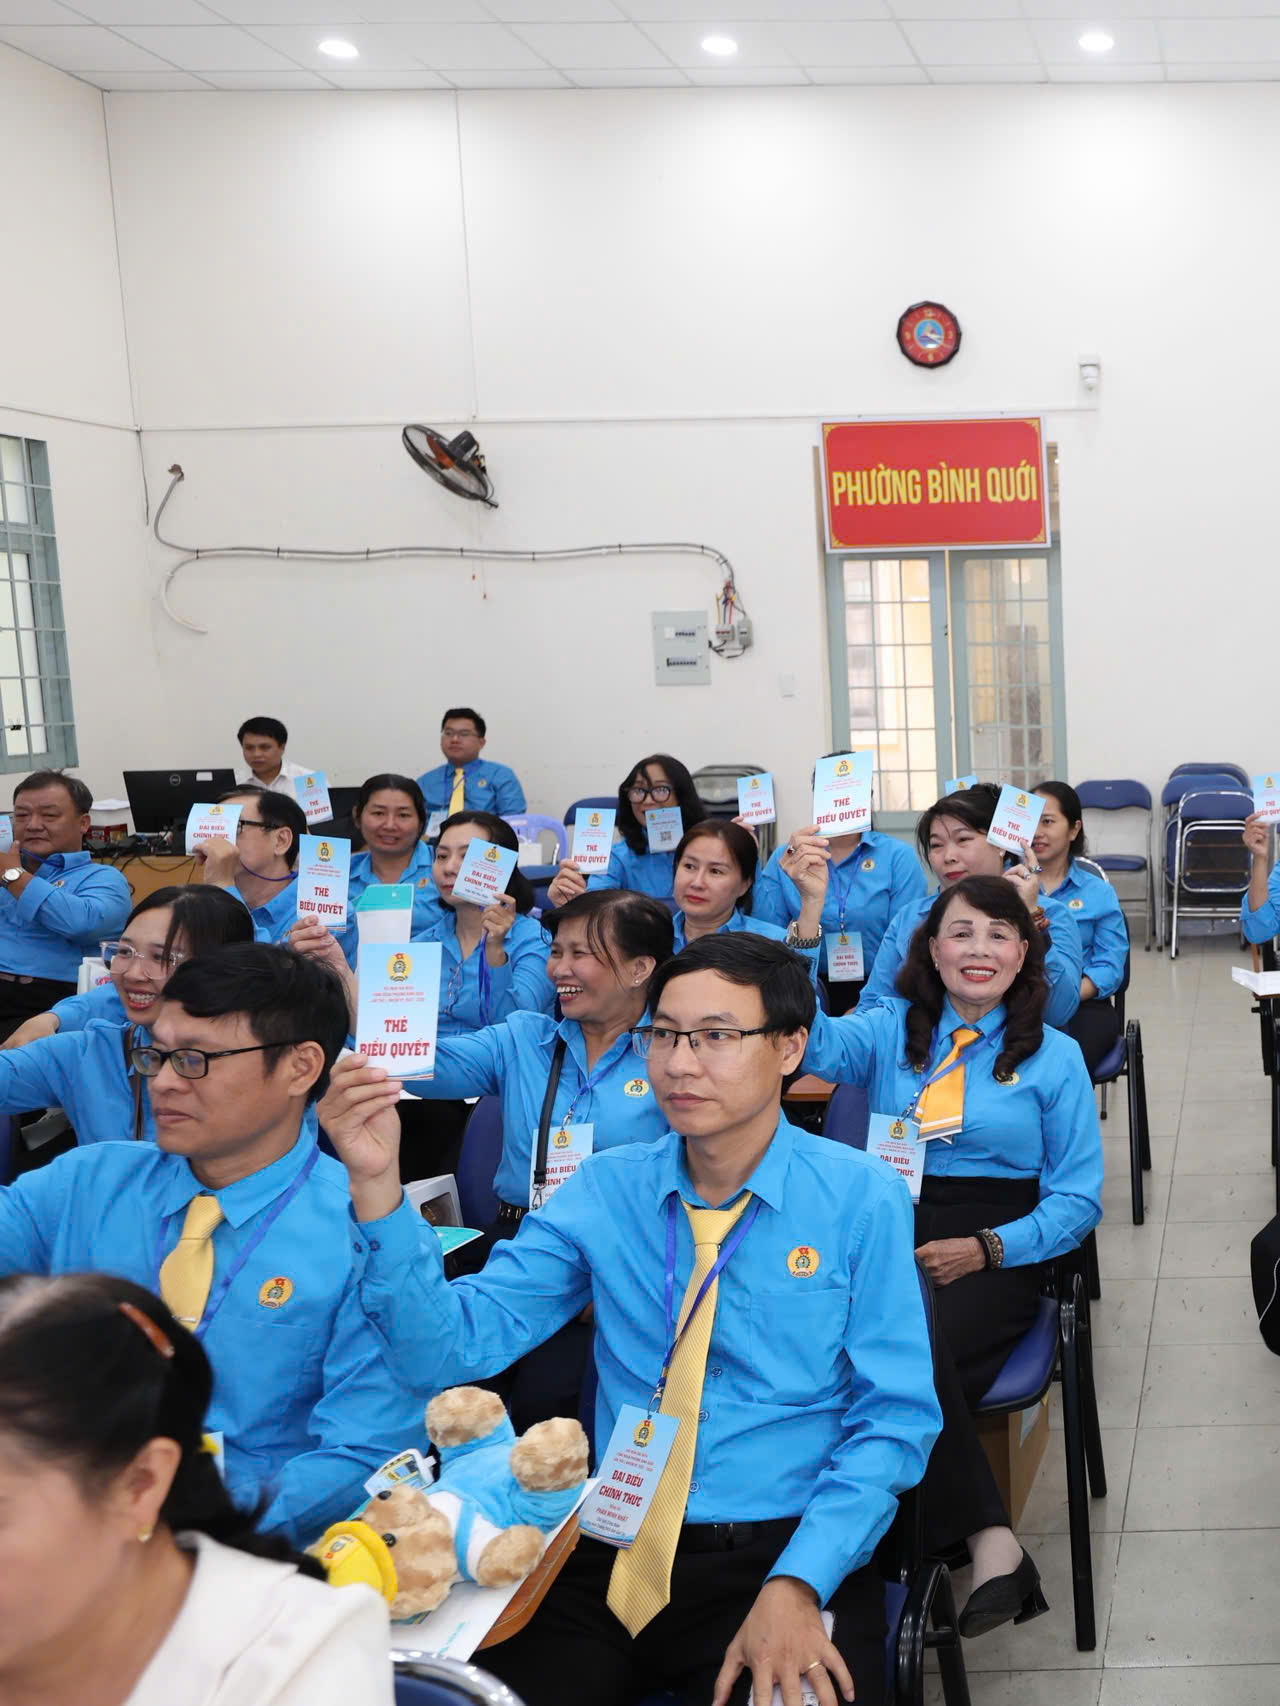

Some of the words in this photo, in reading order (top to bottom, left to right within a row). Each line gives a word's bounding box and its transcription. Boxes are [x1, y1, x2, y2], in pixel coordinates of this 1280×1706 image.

[832, 462, 922, 506] PHƯỜNG
[927, 461, 981, 504] BÌNH
[986, 459, 1038, 504] QUỚI
[384, 1016, 408, 1032] THẺ
[360, 1037, 387, 1056] BIỂU
[390, 1037, 430, 1058] QUYẾT
[611, 1470, 625, 1483] ĐẠI
[626, 1472, 644, 1487] BIỂU
[599, 1485, 621, 1500] CHÍNH
[622, 1491, 642, 1507] THỨC
